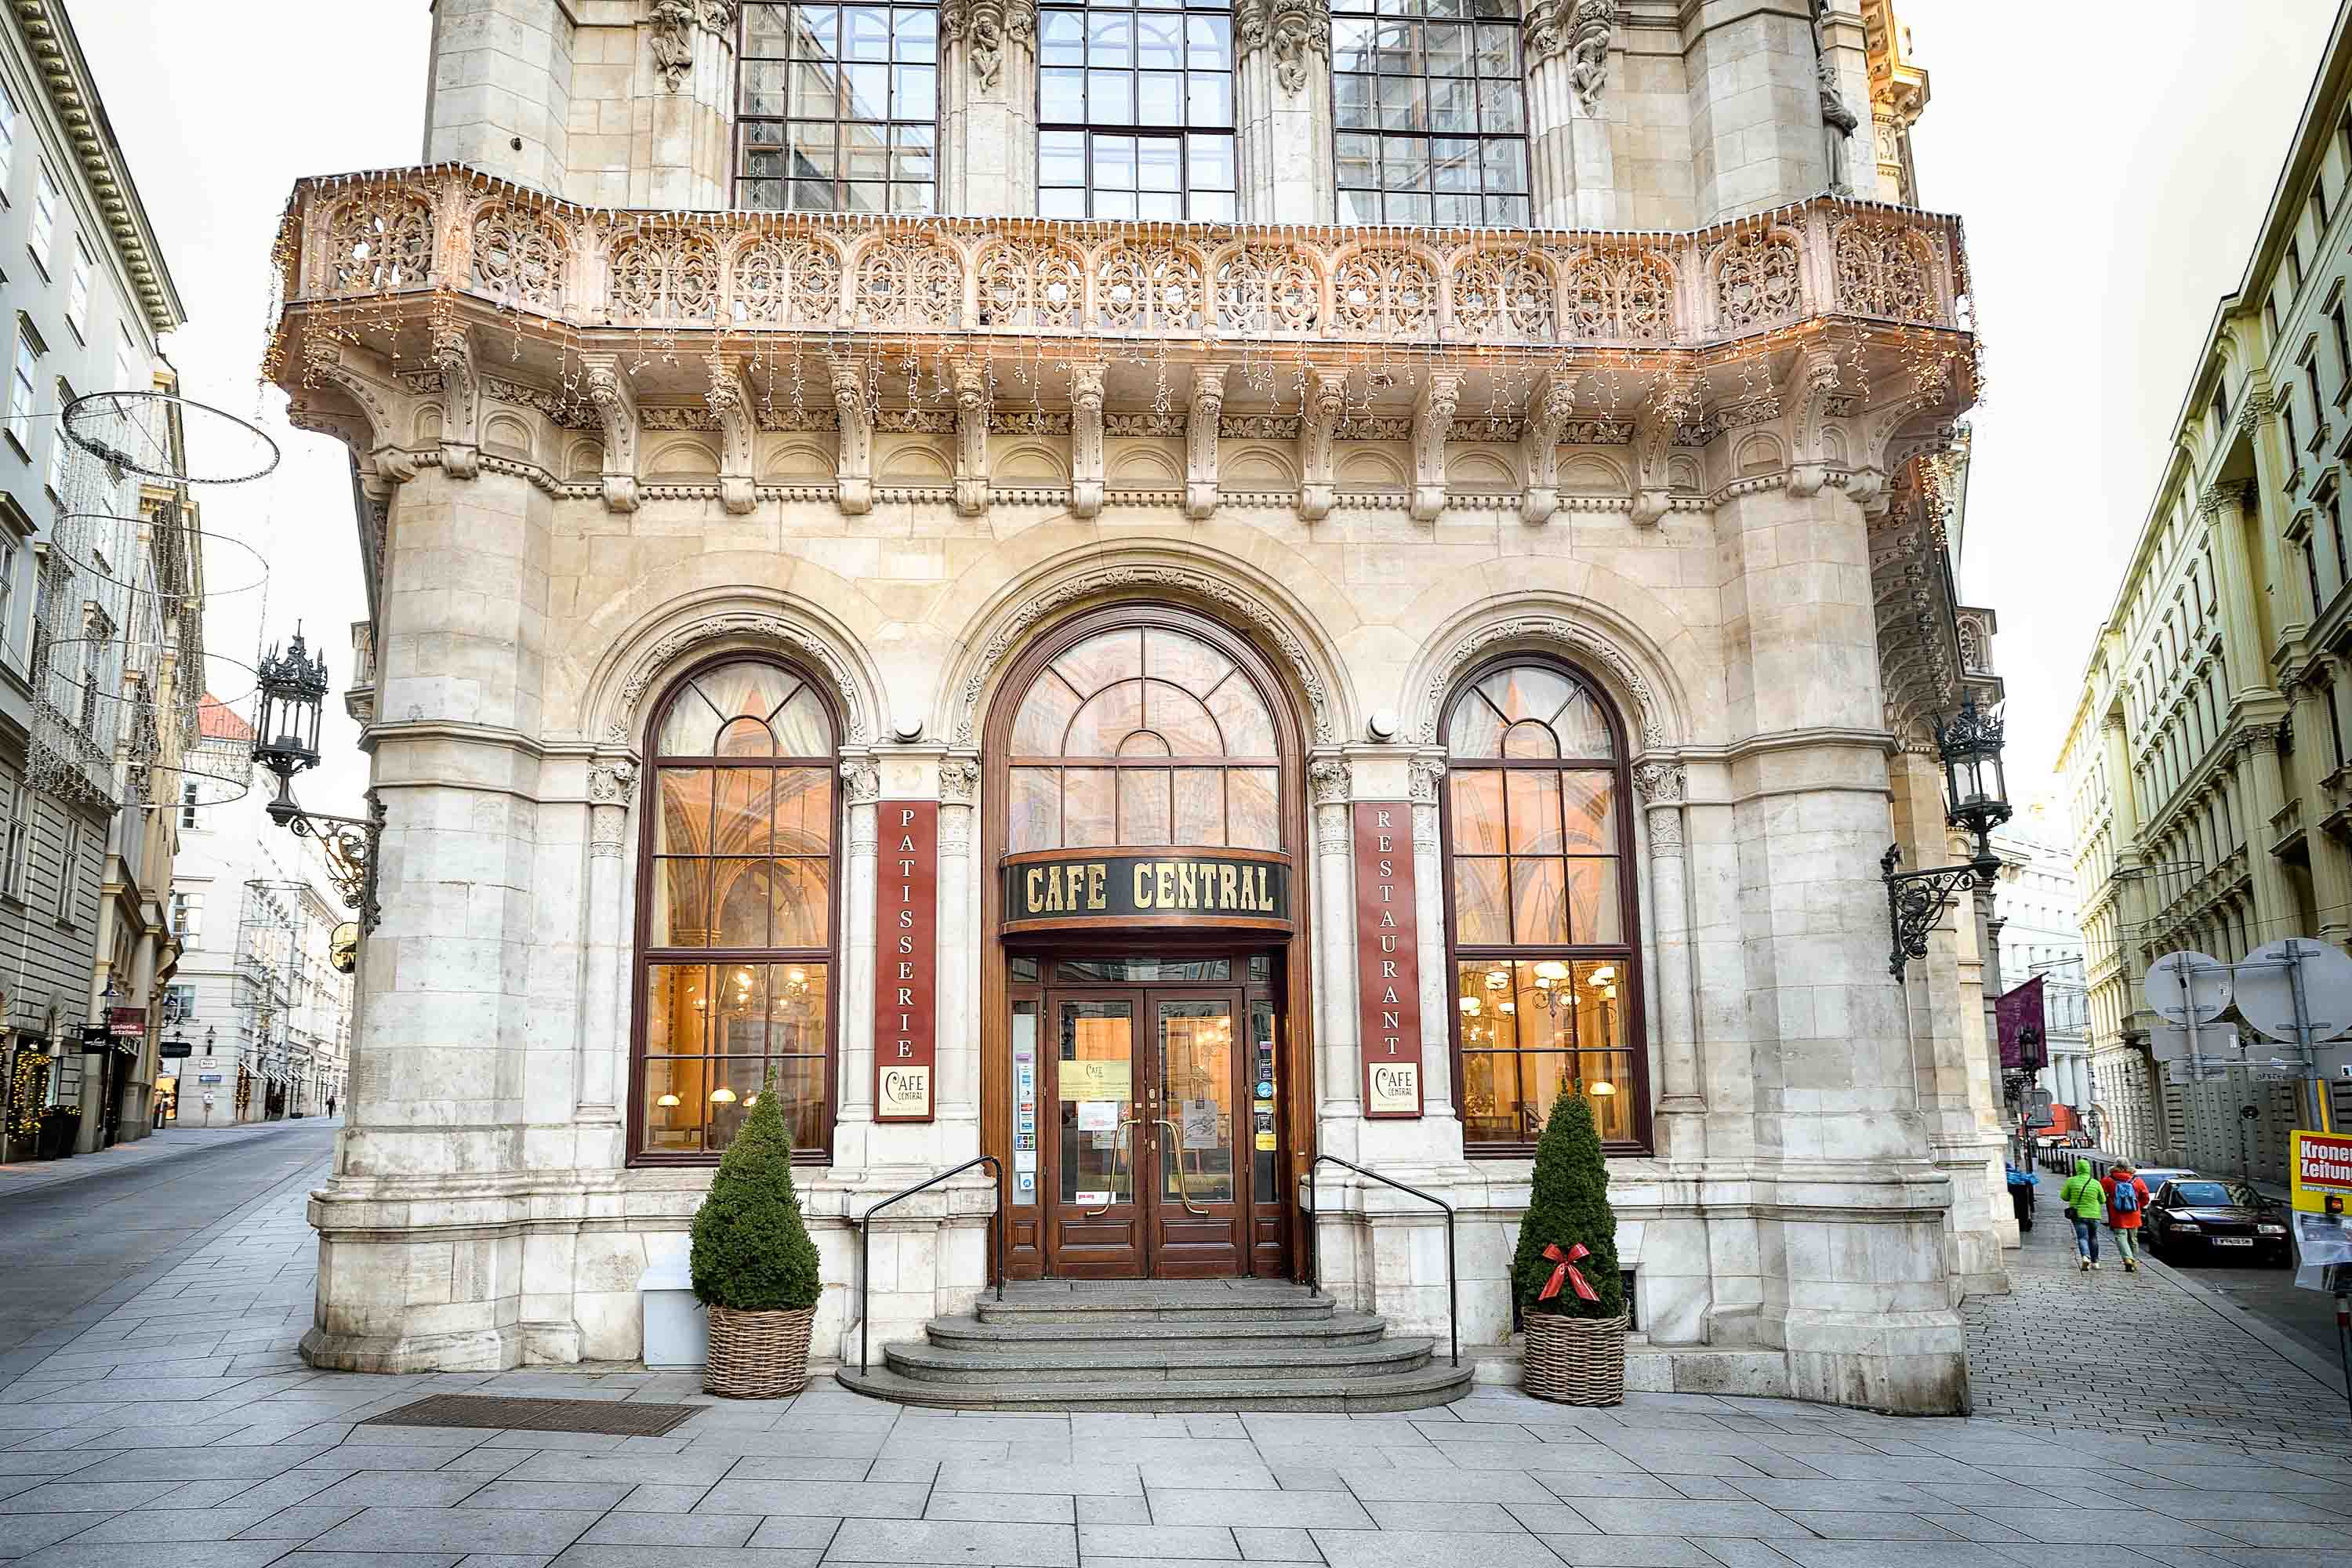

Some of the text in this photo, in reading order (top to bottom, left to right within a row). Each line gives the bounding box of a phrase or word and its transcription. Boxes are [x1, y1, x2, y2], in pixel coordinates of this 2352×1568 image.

[1026, 862, 1273, 913] CAFE CENTRAL
[896, 808, 916, 1058] PATISSERIE
[1376, 809, 1399, 1055] RESTAURANT
[885, 1071, 924, 1104] CAFE
[898, 1091, 923, 1100] CENTRAL
[1376, 1068, 1412, 1100] CAFE
[1388, 1087, 1412, 1096] CENTRAL
[2301, 1159, 2352, 1182] Zeitun
